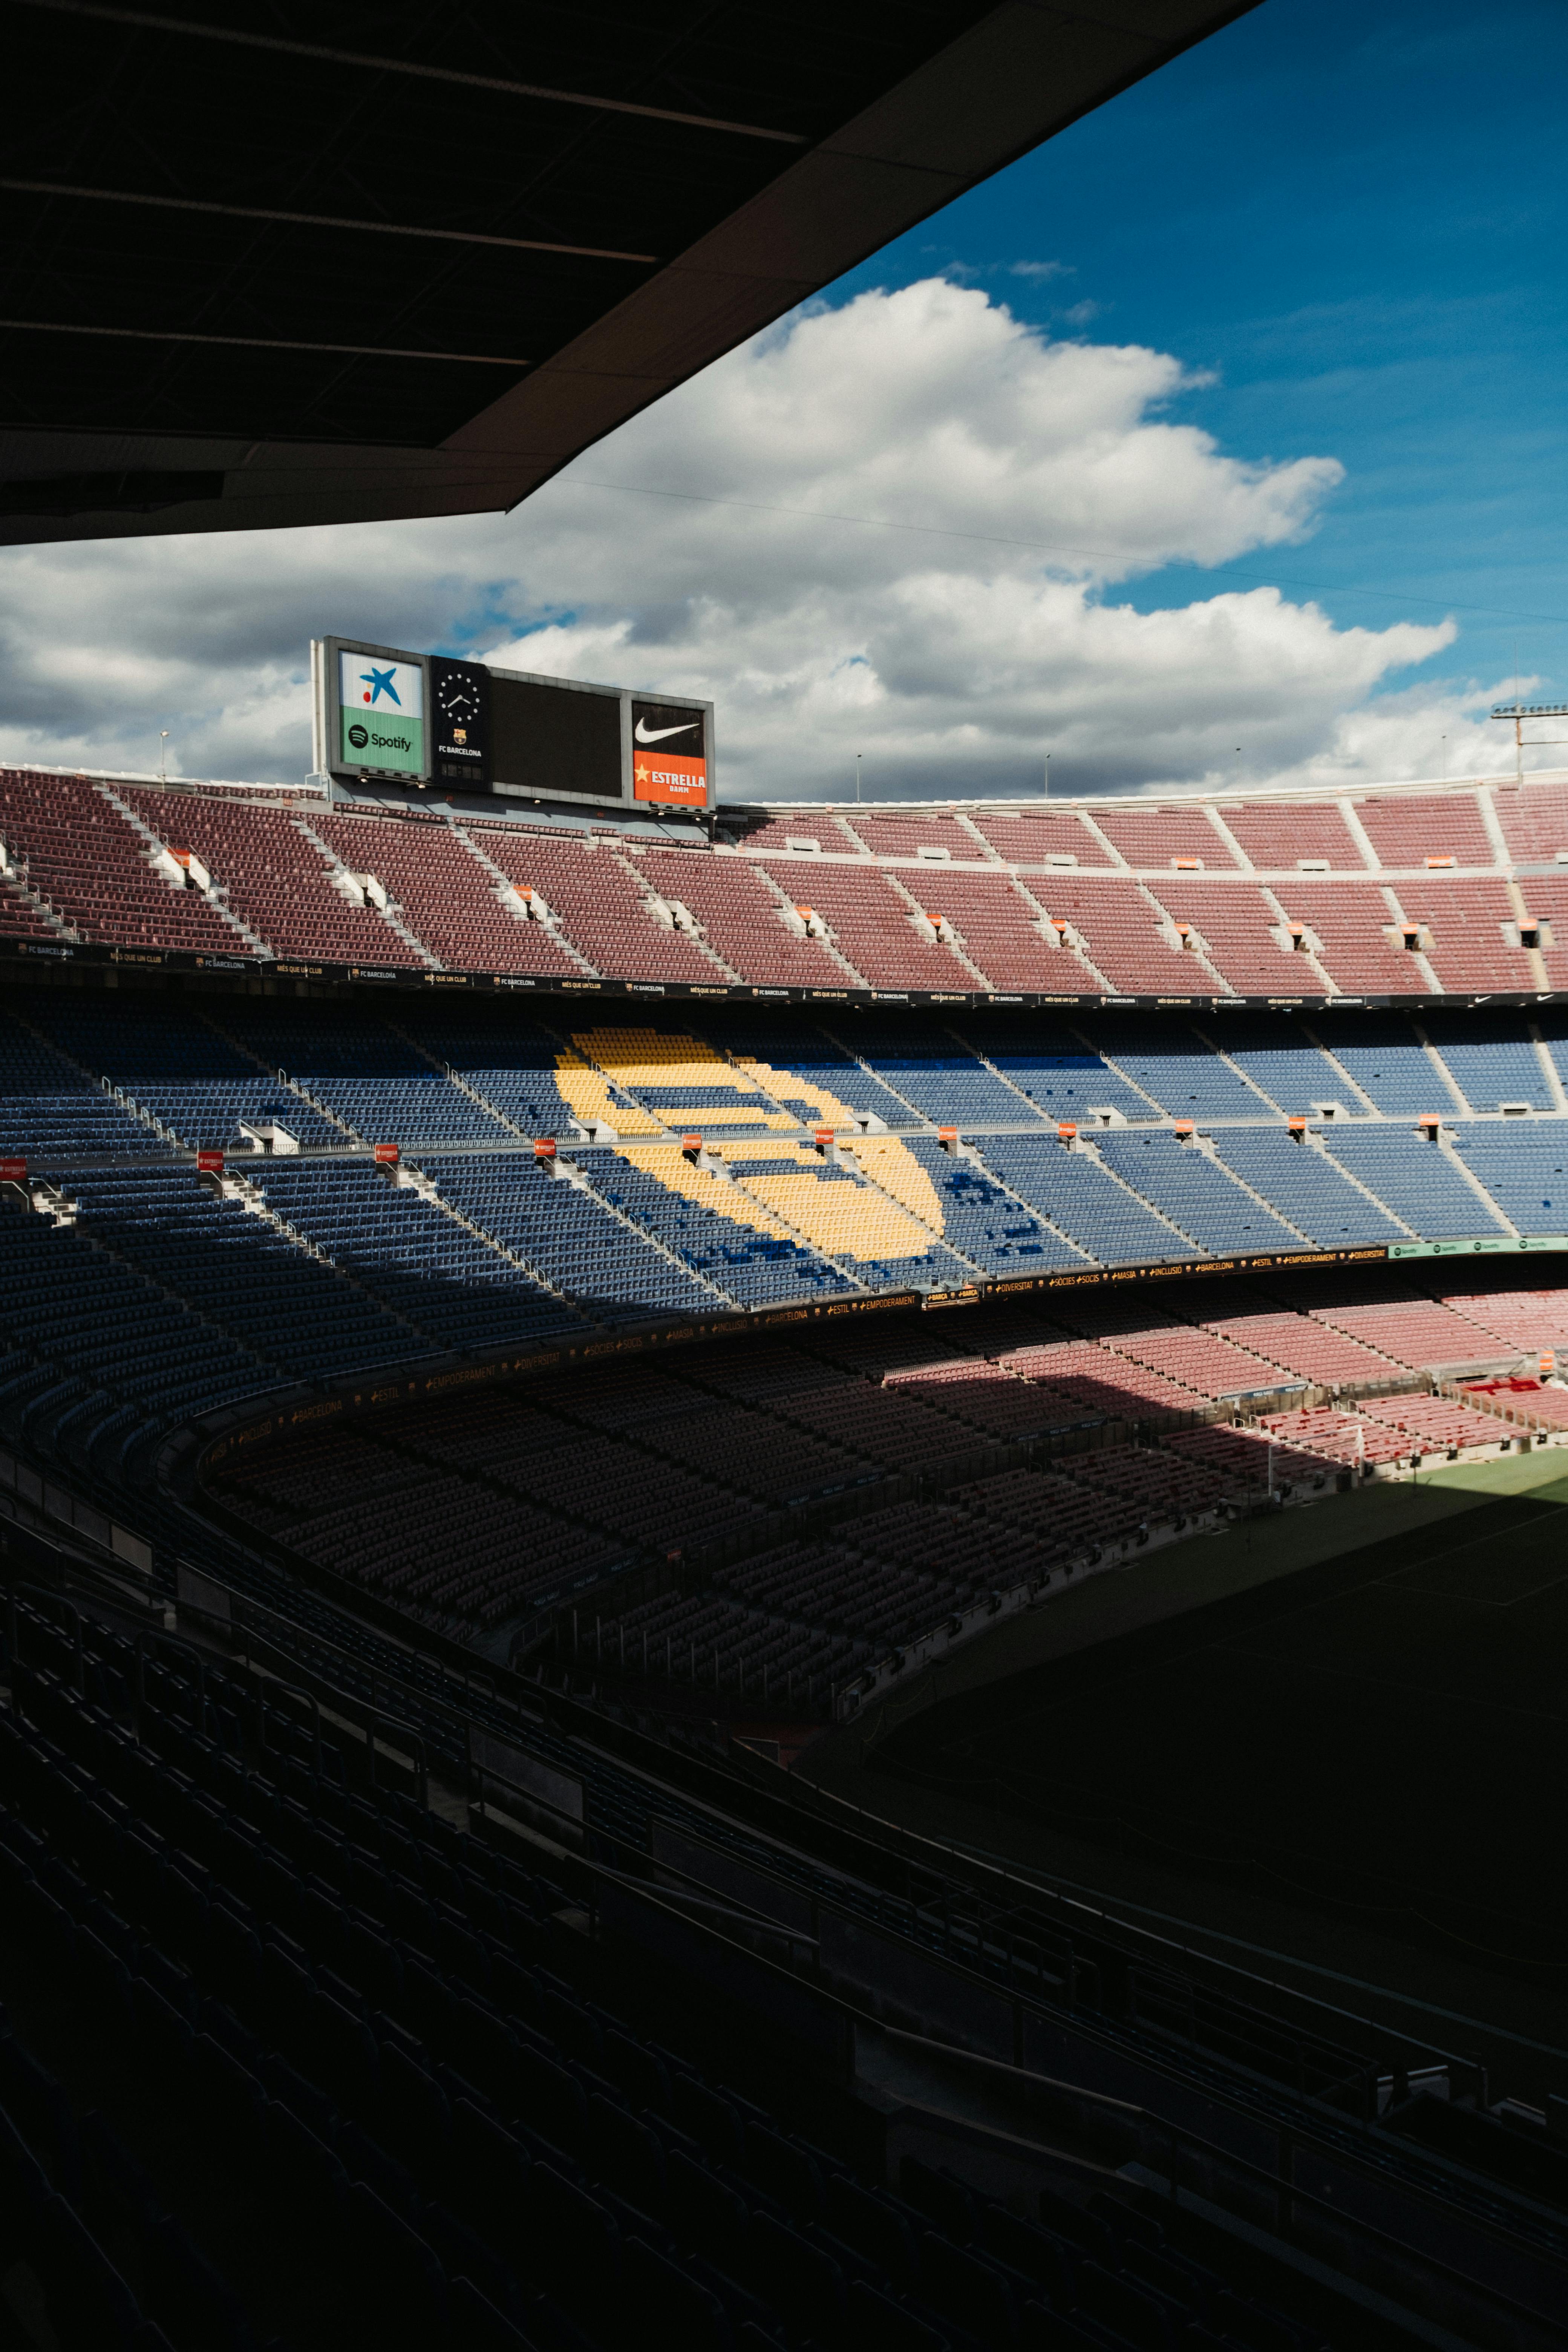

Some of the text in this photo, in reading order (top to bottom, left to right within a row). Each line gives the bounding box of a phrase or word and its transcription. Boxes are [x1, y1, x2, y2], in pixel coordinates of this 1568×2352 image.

[371, 733, 410, 752] Spotify
[447, 746, 482, 757] BARCELONA
[651, 771, 705, 788] ESTRELLA
[669, 785, 689, 793] DAMM
[37, 947, 74, 956] BARCELONA
